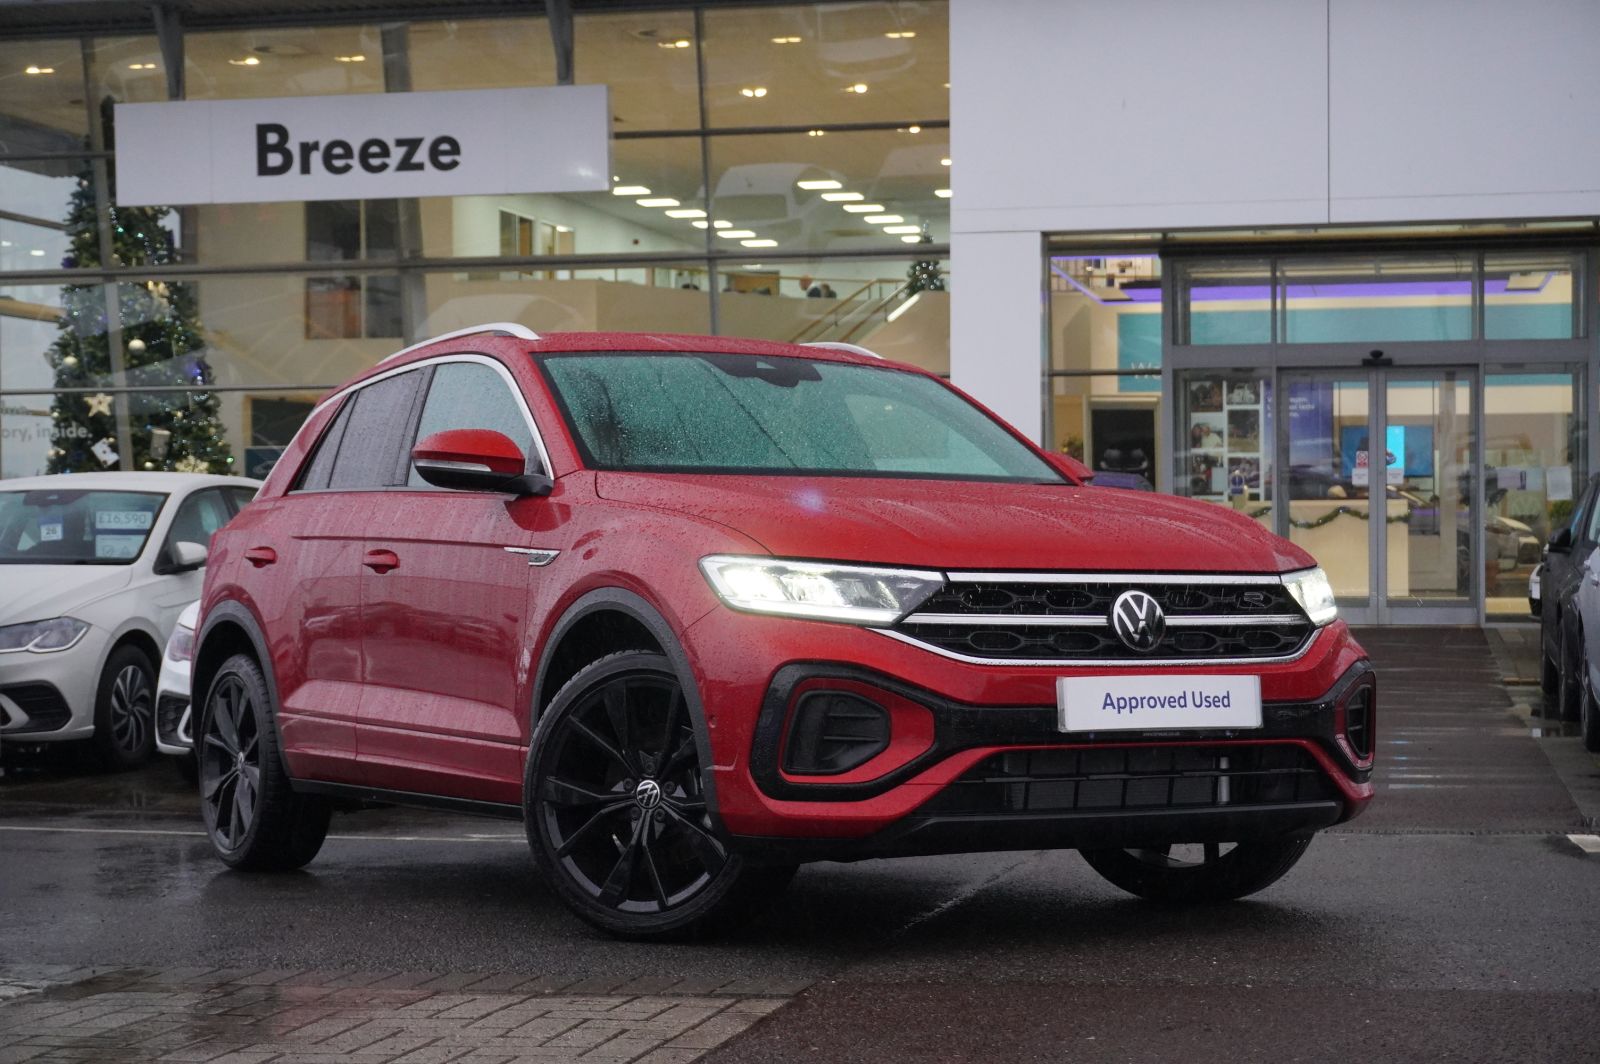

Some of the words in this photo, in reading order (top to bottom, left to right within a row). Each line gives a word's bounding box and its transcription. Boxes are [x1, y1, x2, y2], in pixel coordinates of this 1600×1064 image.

[256, 123, 461, 176] Breeze
[36, 421, 93, 439] inside.
[1102, 690, 1187, 714] Approved
[1192, 690, 1231, 709] Used
